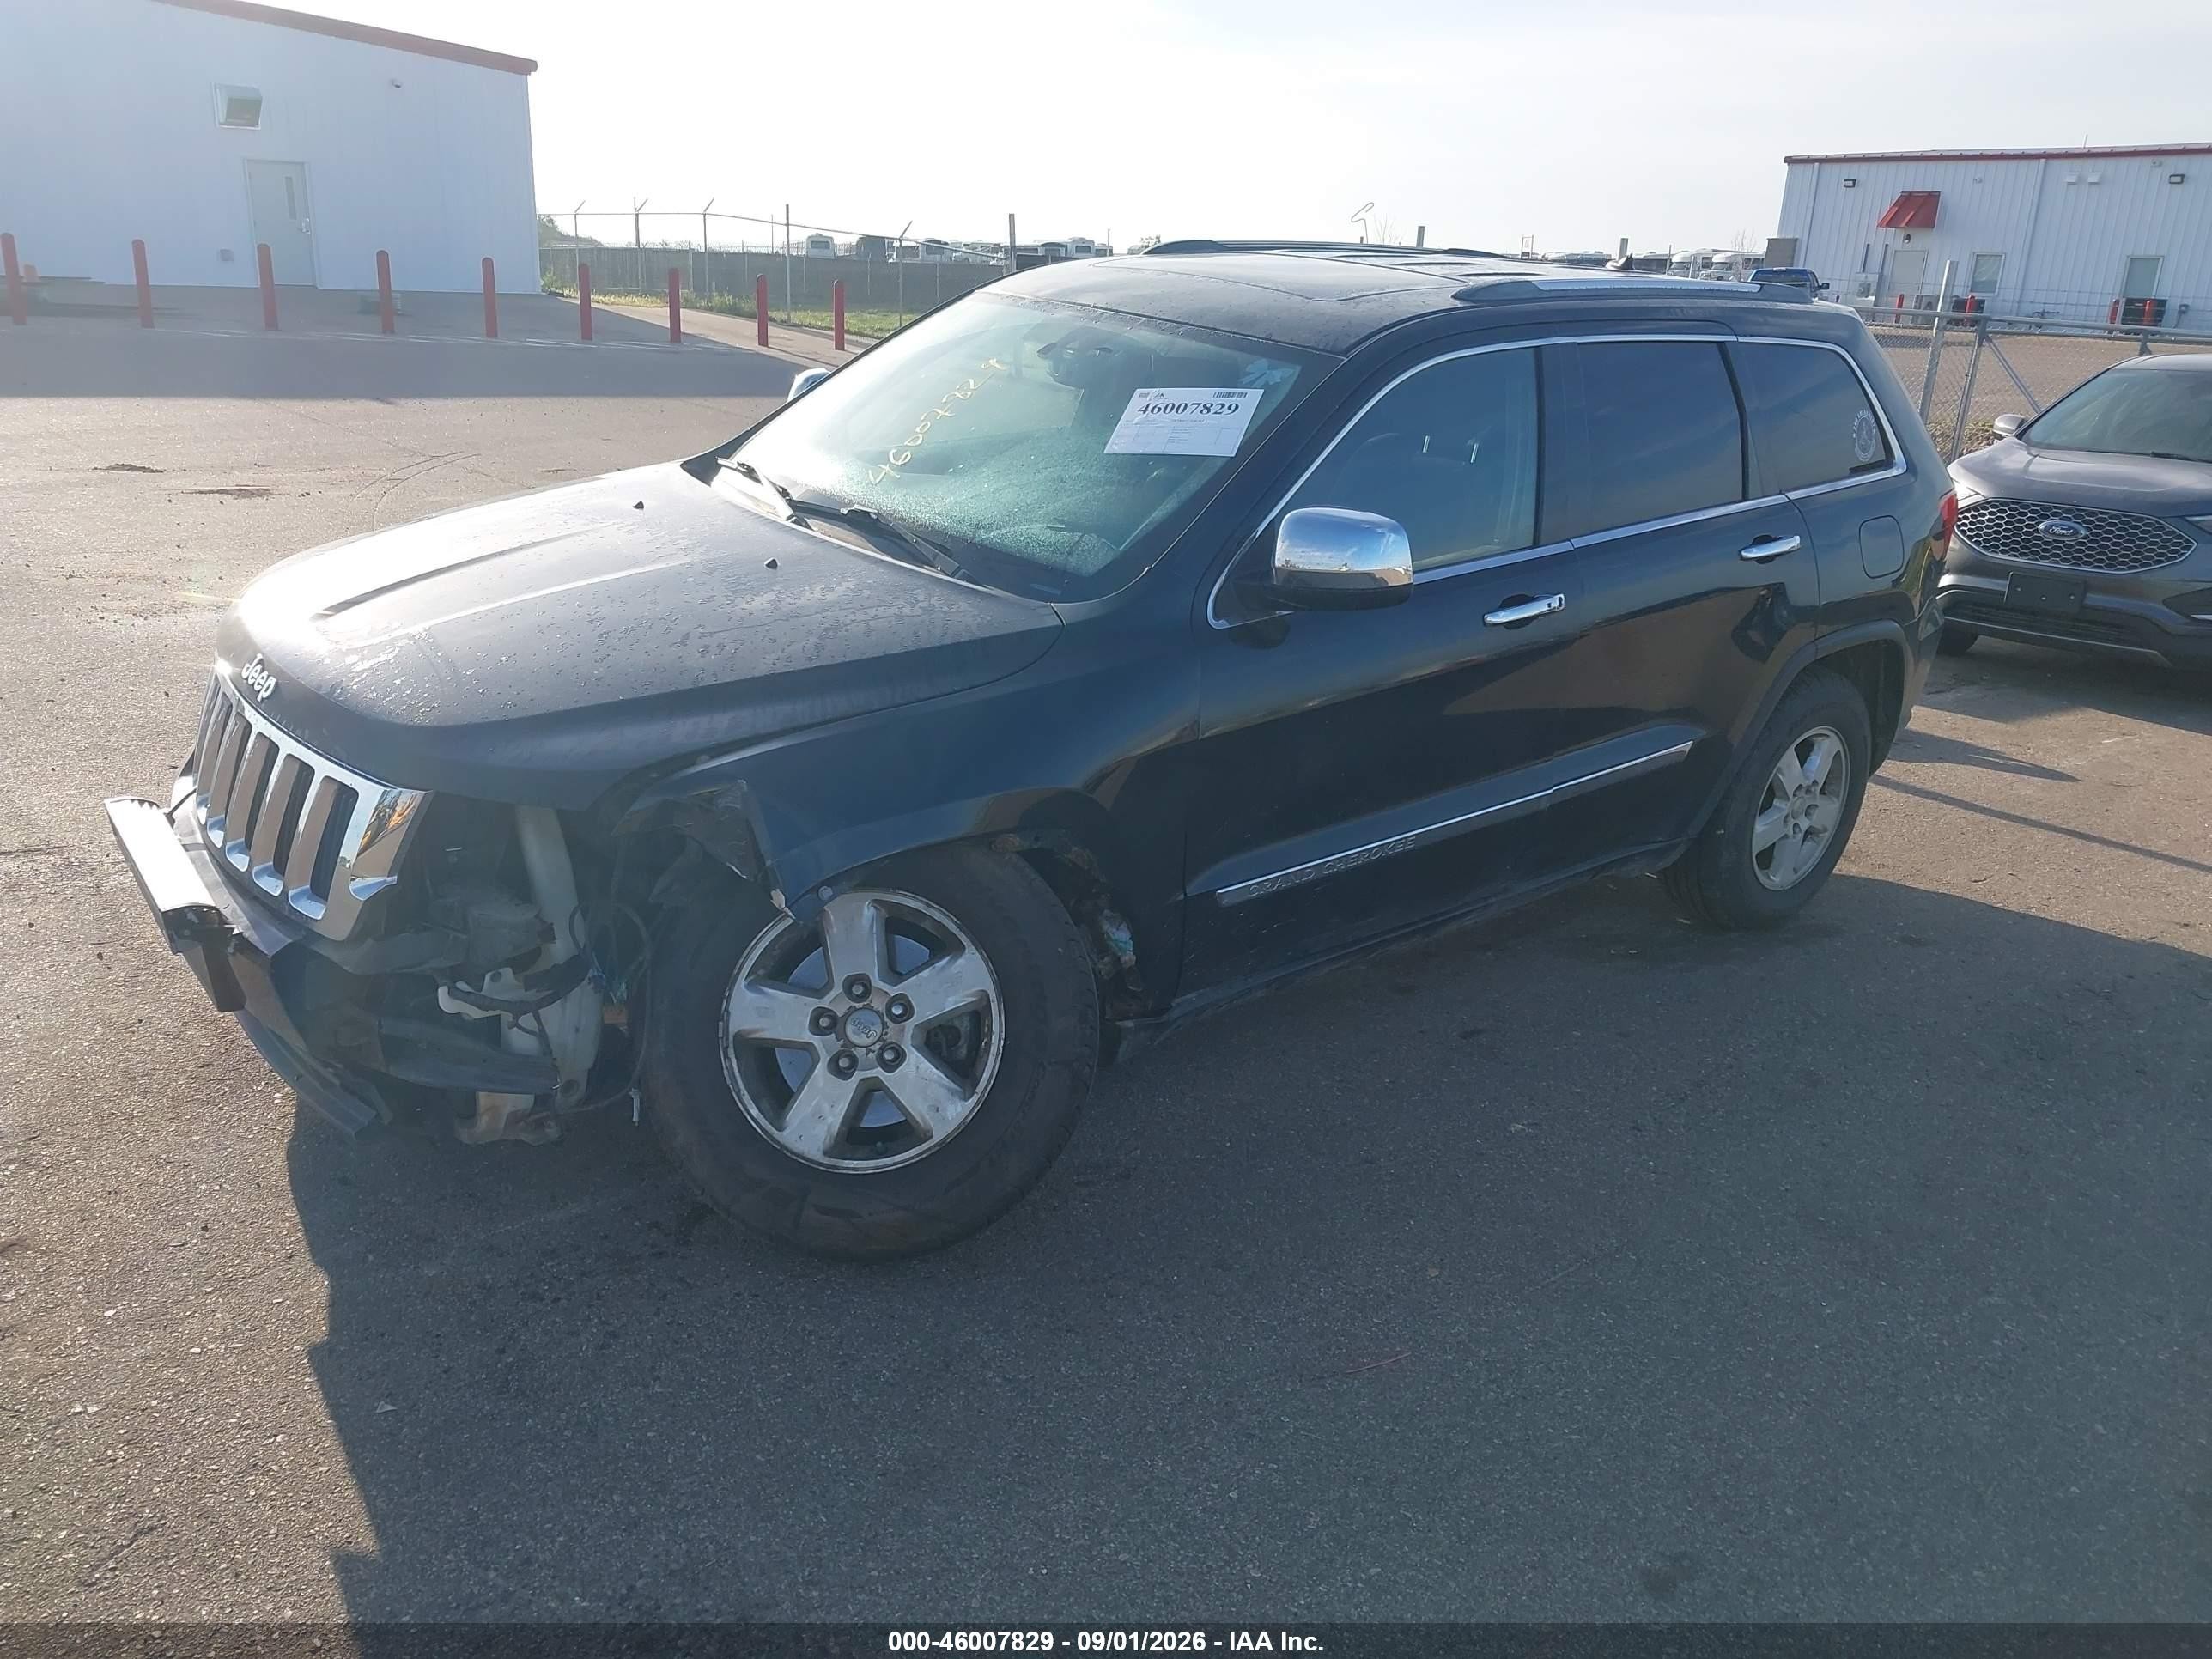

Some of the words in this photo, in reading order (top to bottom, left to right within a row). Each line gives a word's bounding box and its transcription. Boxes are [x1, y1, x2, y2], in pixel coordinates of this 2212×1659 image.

[1138, 403, 1239, 416] 46007829
[241, 653, 276, 702] Jeep
[1248, 869, 1316, 896] GRAND
[1322, 836, 1416, 874] CHEROKEE
